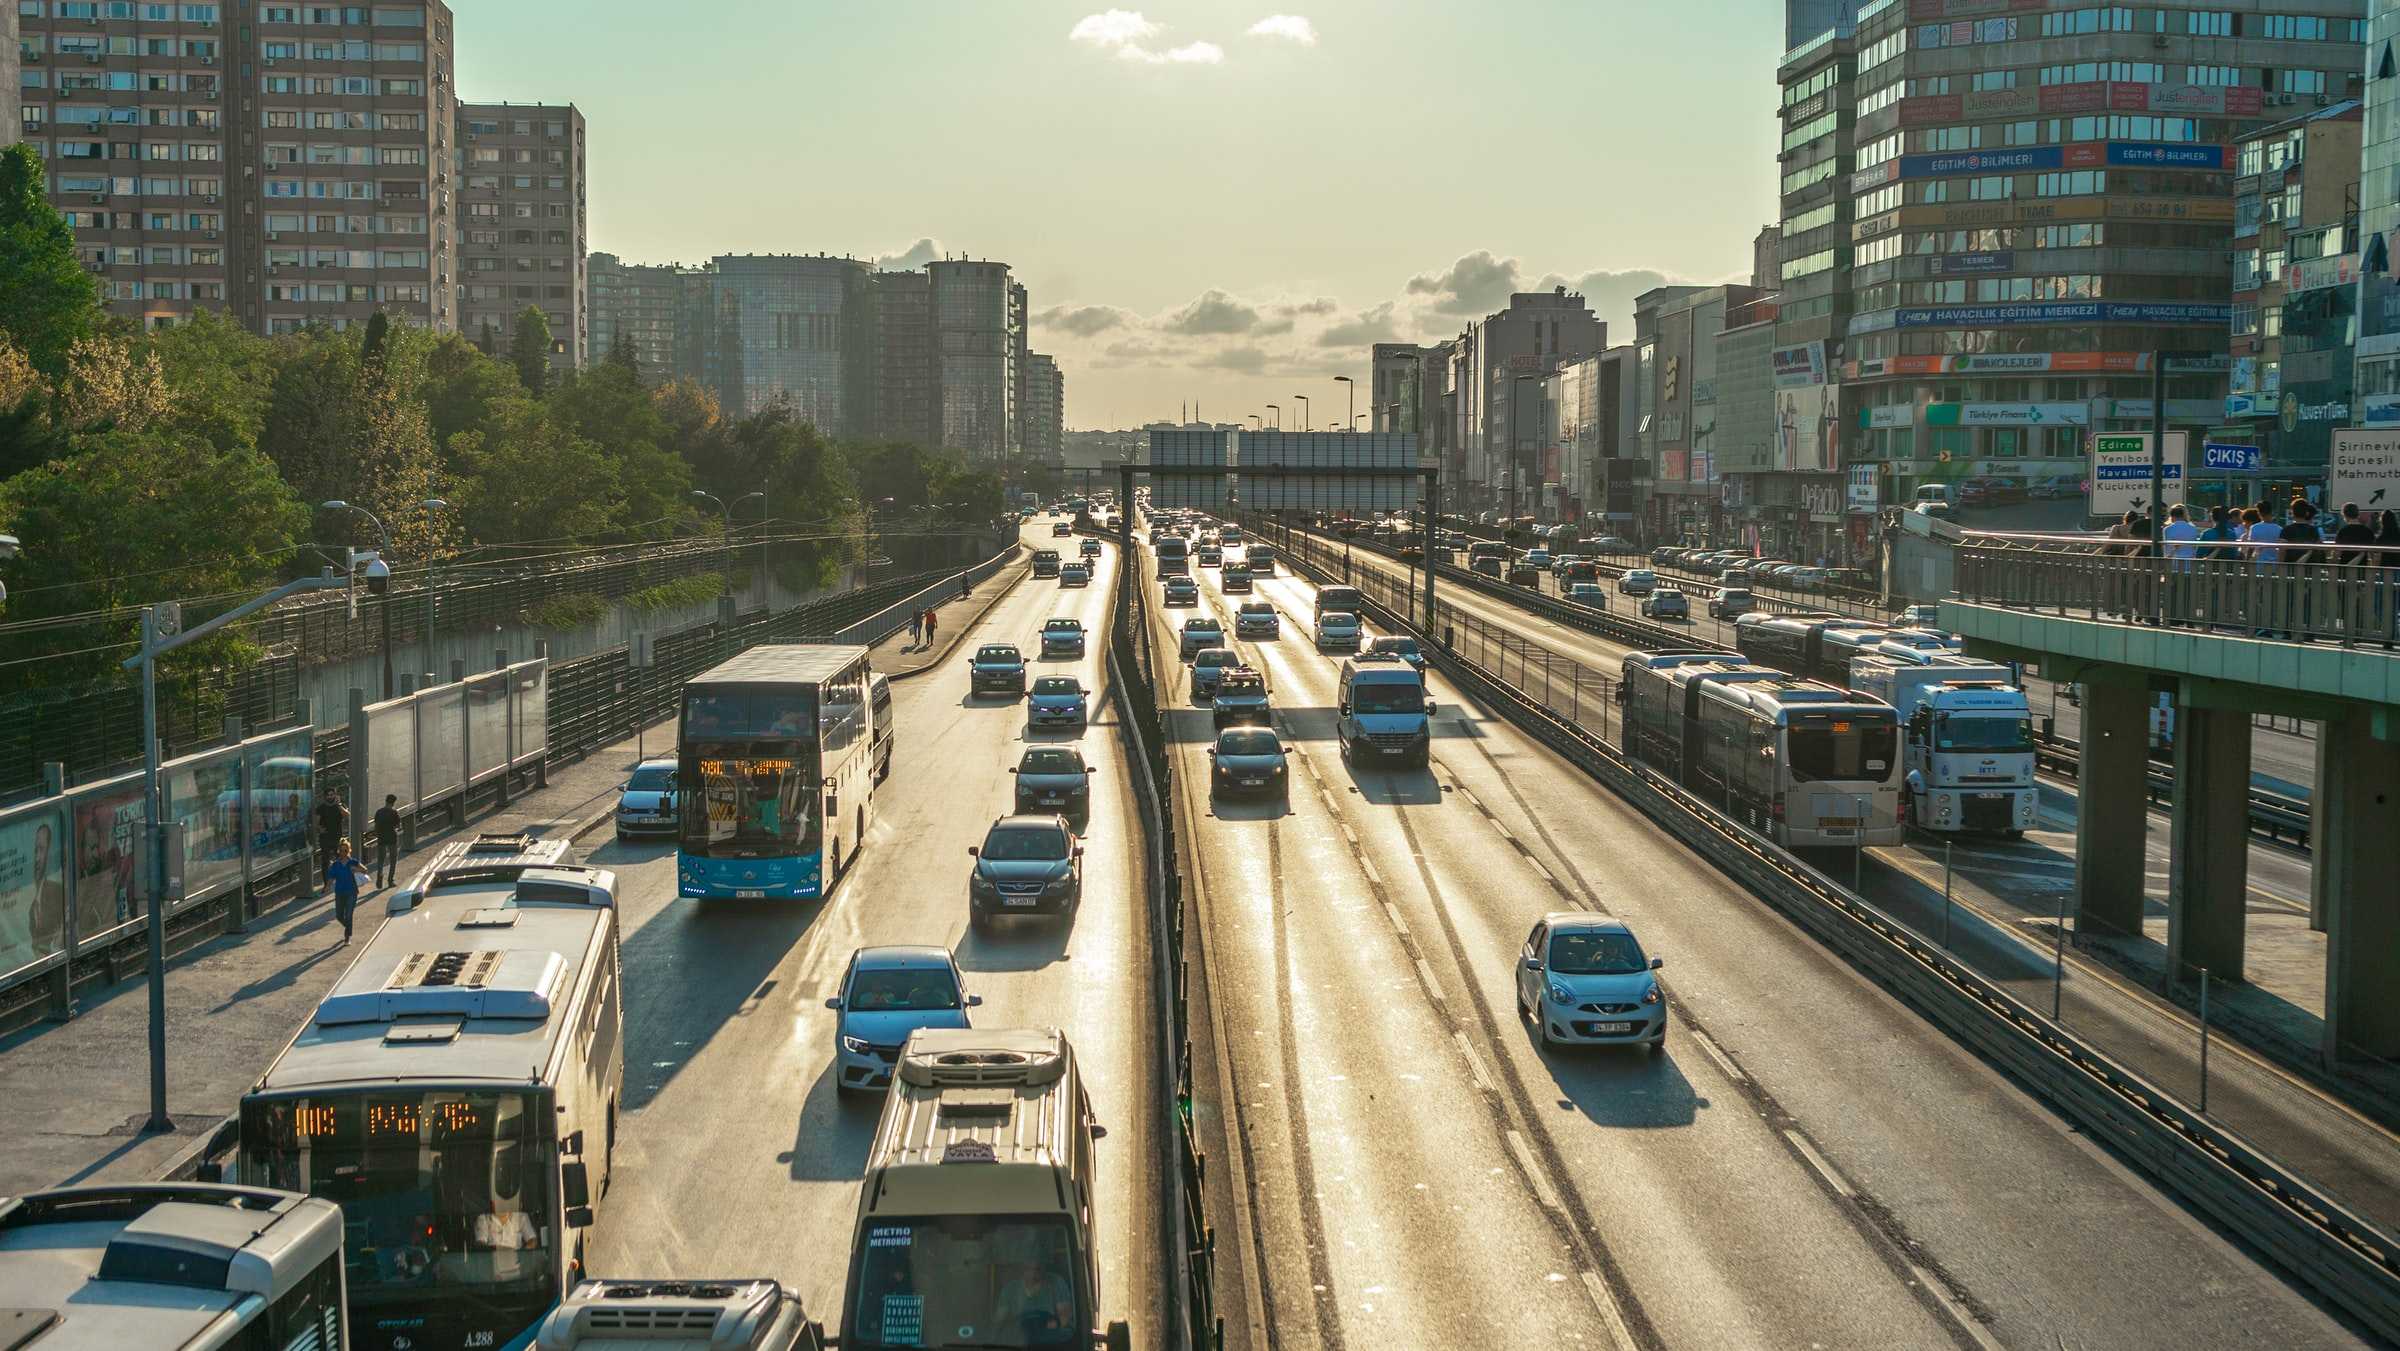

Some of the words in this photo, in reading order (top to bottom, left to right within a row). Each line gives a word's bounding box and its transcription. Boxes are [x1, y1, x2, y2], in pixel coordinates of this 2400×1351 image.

[1936, 308, 1997, 320] HAVACILIK
[2000, 304, 2041, 317] EĞİTİM
[2045, 303, 2097, 316] MERKEZİ
[2100, 440, 2141, 450] Edirne
[2207, 448, 2246, 467] ÇIKIŞ
[1801, 484, 1840, 514] DeFacto
[873, 1227, 911, 1237] METRO
[870, 1237, 912, 1247] METROBÜS
[464, 1331, 495, 1348] A.288
